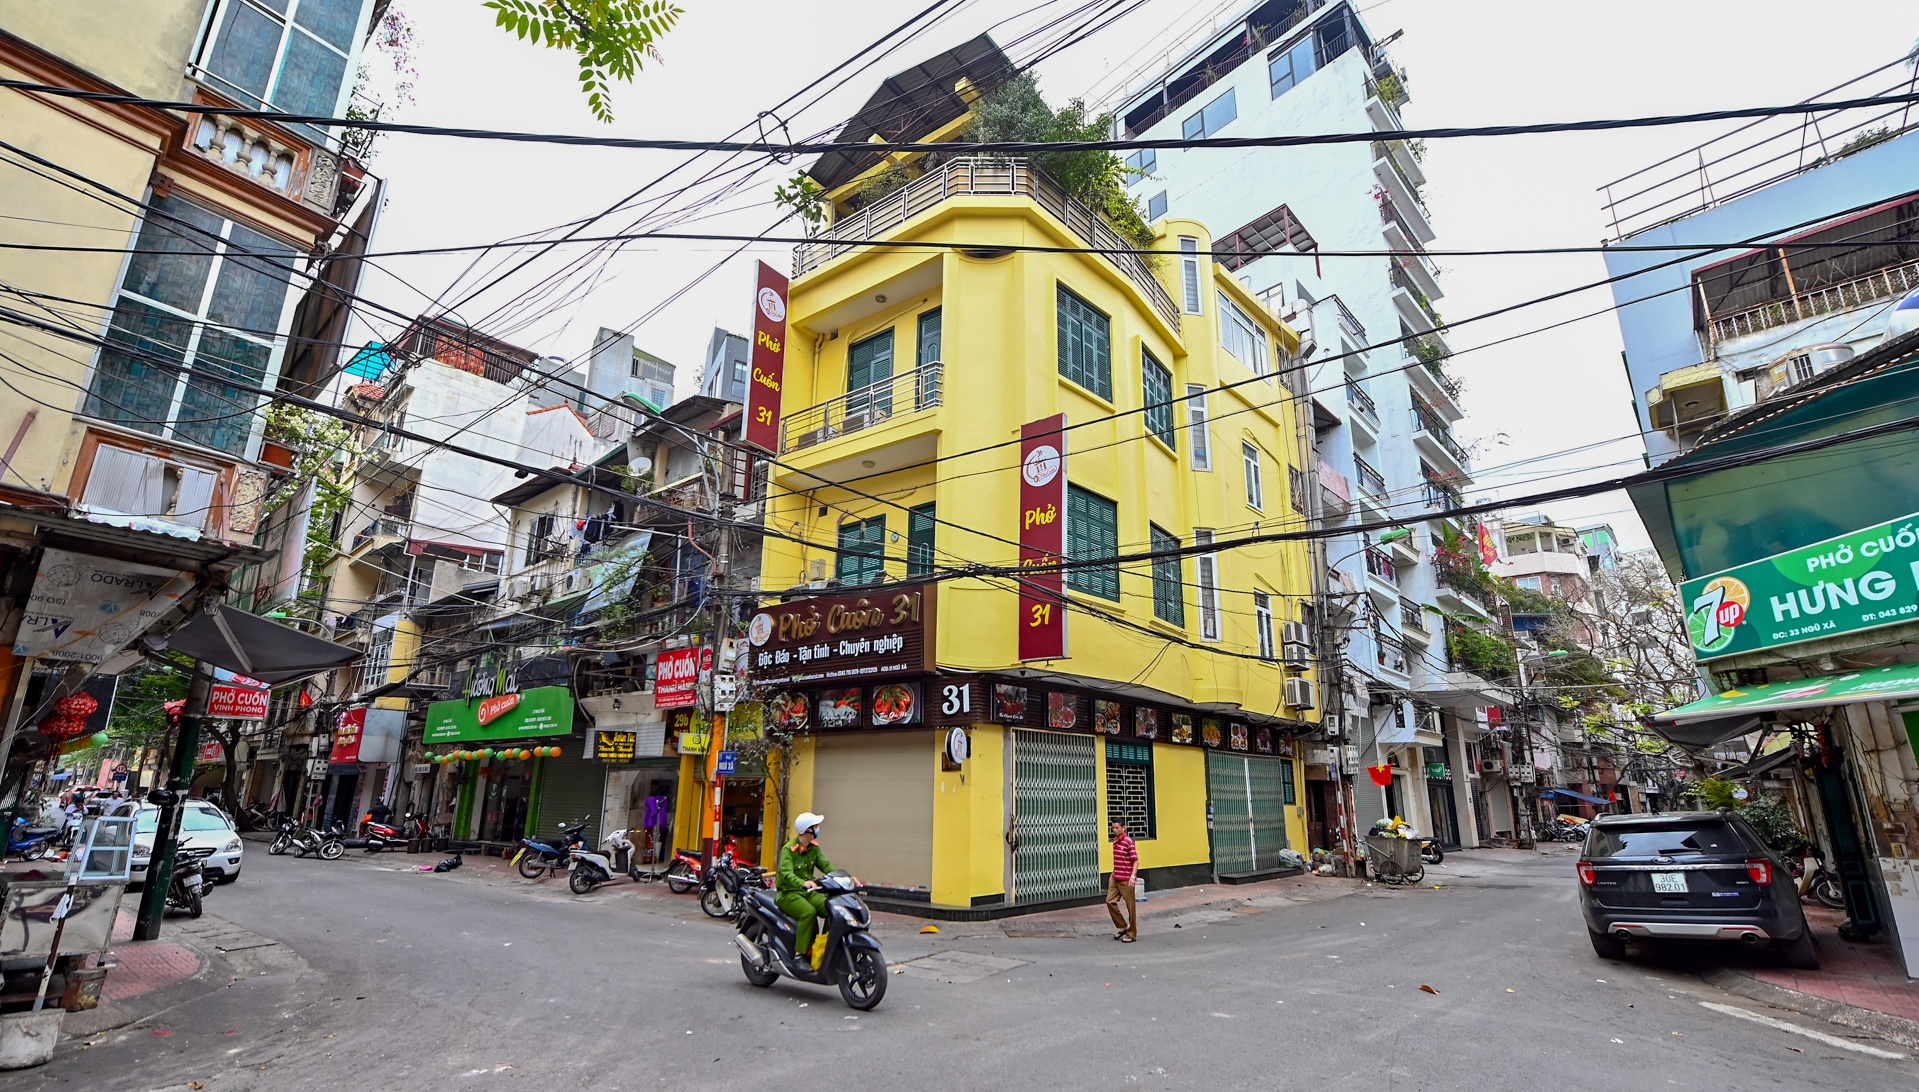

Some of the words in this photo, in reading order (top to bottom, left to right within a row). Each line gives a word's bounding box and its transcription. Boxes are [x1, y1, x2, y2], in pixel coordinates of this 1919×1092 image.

[757, 329, 781, 354] Phở
[753, 366, 781, 392] Cuốn
[756, 405, 773, 426] 31
[1025, 503, 1057, 531] Phở
[1805, 543, 1855, 573] PHỞ
[1859, 522, 1919, 558] CUỐ
[46, 597, 66, 606] ISO
[1769, 570, 1897, 623] HƯNG
[778, 604, 821, 642] Phở
[889, 591, 922, 625] 31
[1029, 603, 1052, 627] 31
[1879, 607, 1897, 619] 043
[1899, 603, 1918, 615] 829
[1789, 628, 1800, 637] 33
[1801, 623, 1821, 634] NGŨ
[1822, 619, 1837, 629] XÃ
[758, 651, 773, 669] Độc
[775, 648, 790, 664] Đáo
[798, 645, 812, 666] Tận
[813, 643, 830, 659] tình
[839, 637, 870, 657] Chuyên
[873, 633, 903, 654] nghiệp
[495, 659, 522, 695] Mai
[658, 655, 674, 681] PHỞ
[674, 651, 697, 679] CUỐN
[211, 688, 236, 704] PHỞ
[237, 691, 268, 707] CUỐN
[213, 704, 234, 712] VINH
[235, 705, 263, 714] PHONG
[941, 683, 970, 715] 31
[674, 714, 689, 727] 29b
[1655, 883, 1686, 892] 982.01
[1660, 874, 1678, 883] 30E
